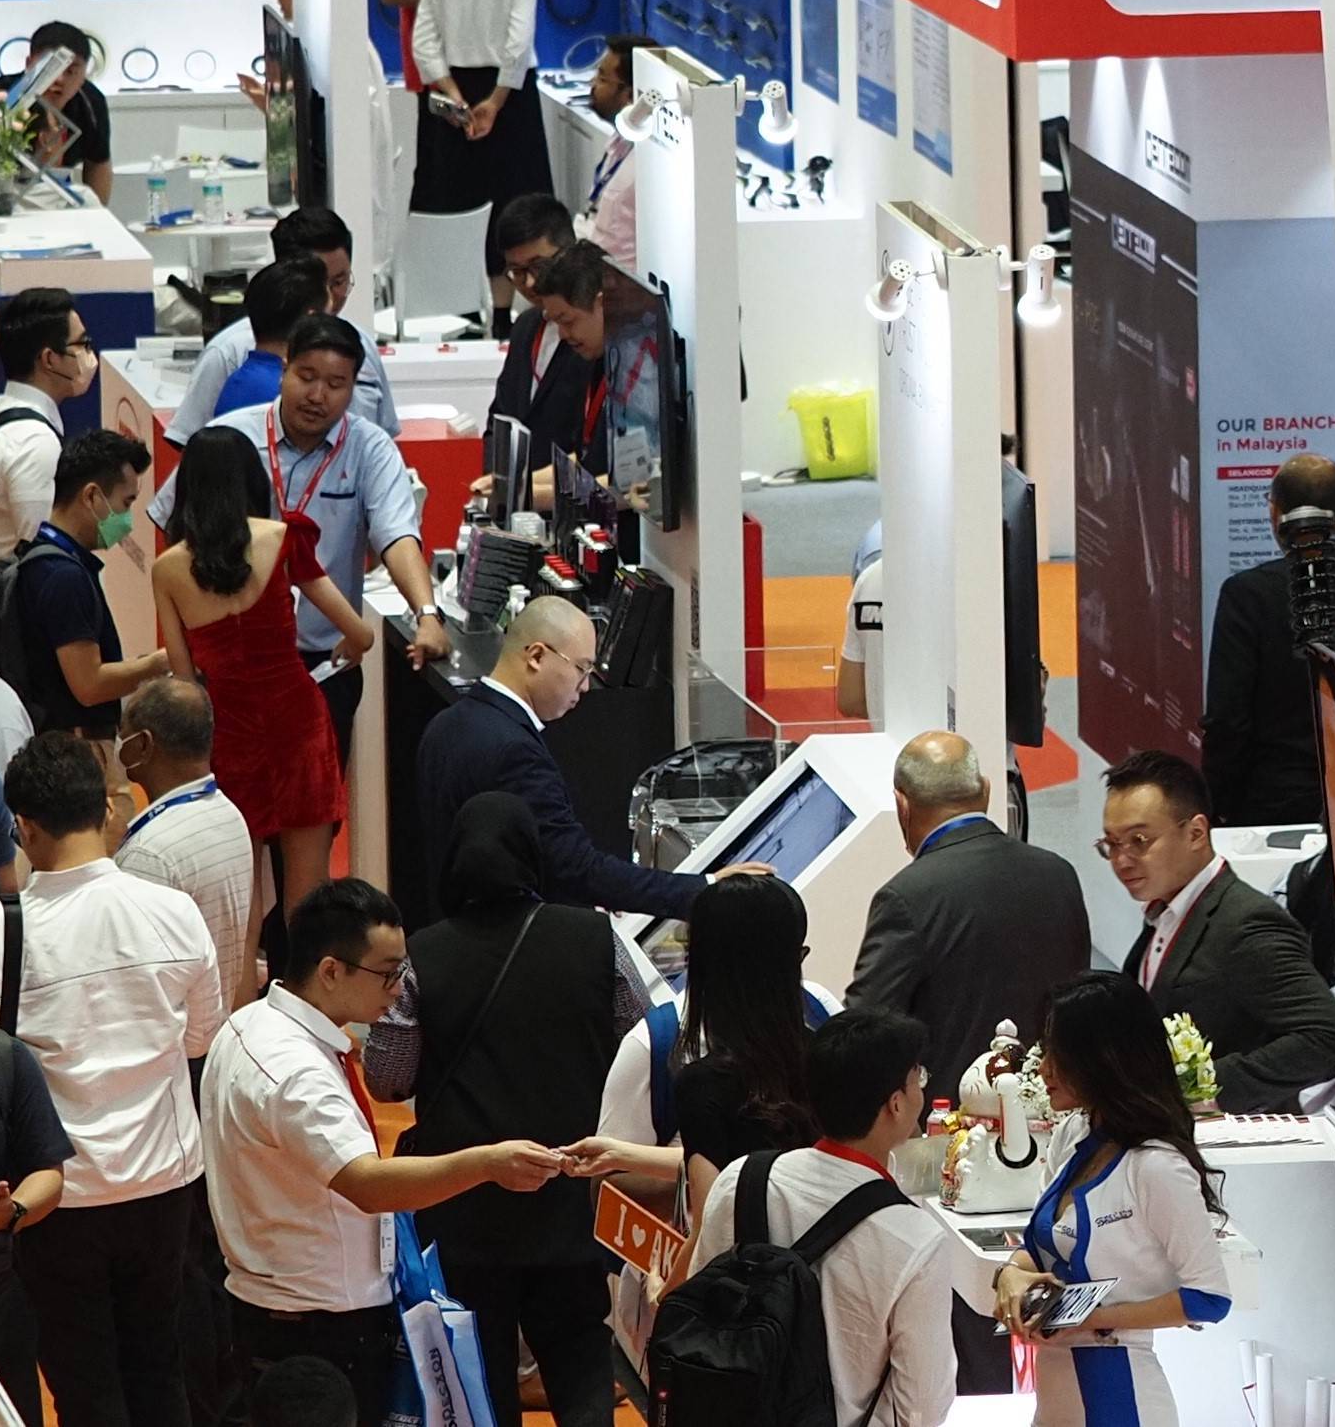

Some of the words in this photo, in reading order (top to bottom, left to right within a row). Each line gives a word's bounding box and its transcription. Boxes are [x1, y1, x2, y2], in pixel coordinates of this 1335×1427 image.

[1217, 418, 1256, 433] OUR
[1217, 439, 1231, 452] in
[1237, 437, 1308, 453] Malaysia
[613, 1203, 628, 1248] I
